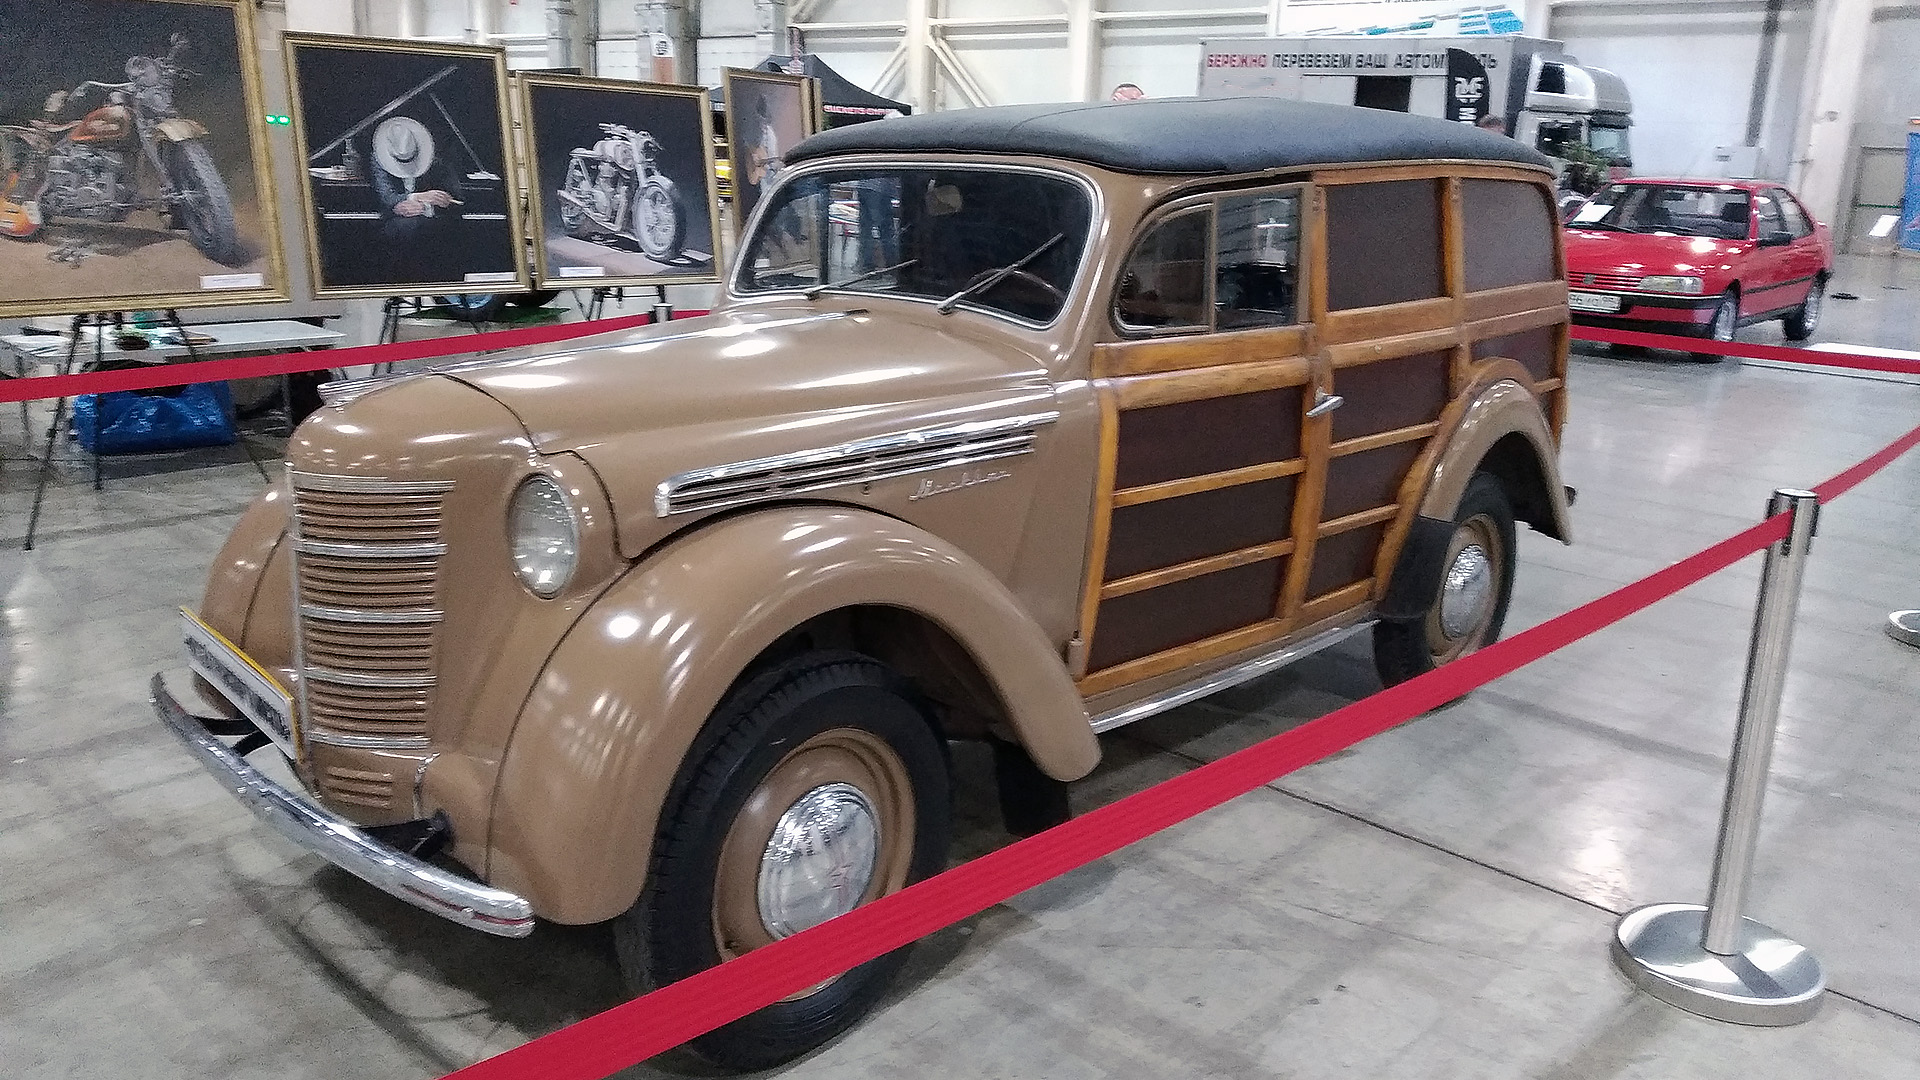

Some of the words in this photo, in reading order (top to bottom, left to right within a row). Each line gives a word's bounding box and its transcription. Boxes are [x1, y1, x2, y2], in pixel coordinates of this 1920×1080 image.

[1207, 53, 1267, 68] БЕРЕЖНО
[1272, 53, 1352, 68] ПЕРЕВЕЗЕМ
[1355, 53, 1388, 69] ВАШ
